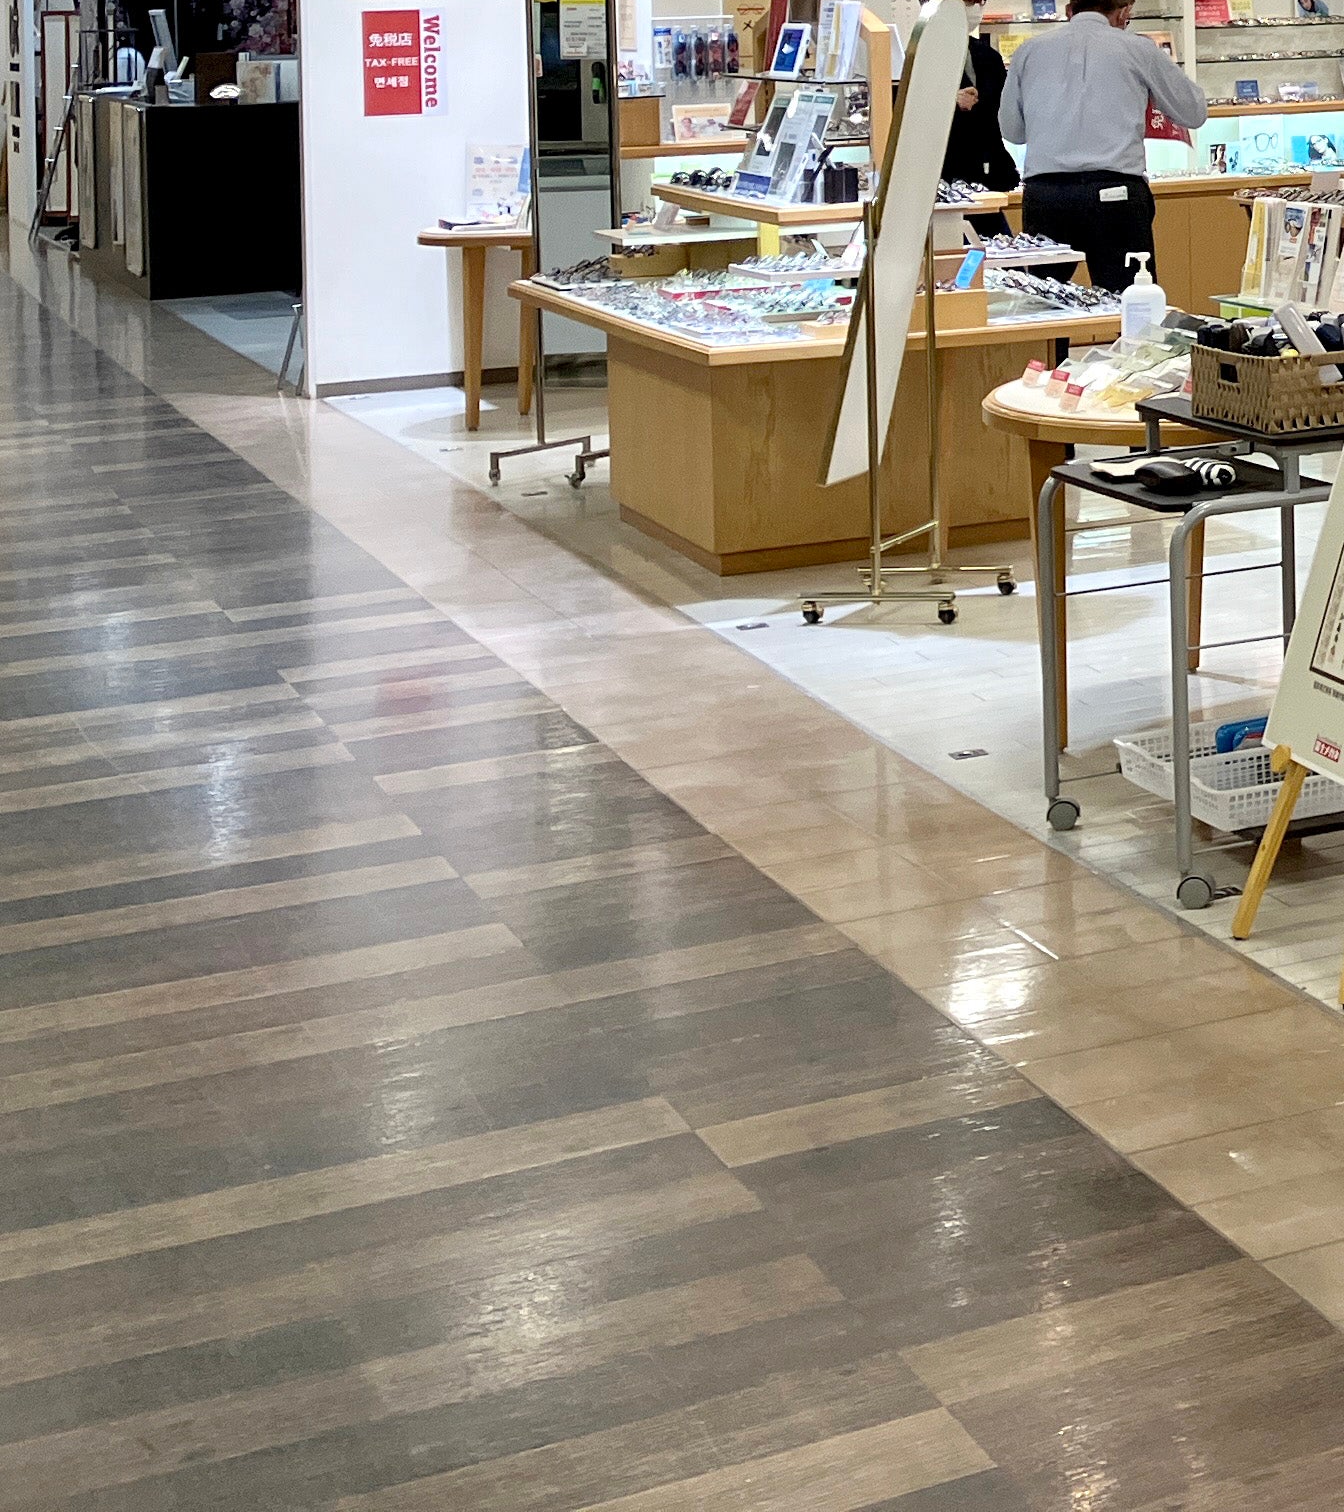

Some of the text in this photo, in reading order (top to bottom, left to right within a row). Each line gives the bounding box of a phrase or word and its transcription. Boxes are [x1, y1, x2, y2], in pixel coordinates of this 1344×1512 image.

[368, 33, 413, 47] 免税店
[423, 14, 440, 108] Welcome
